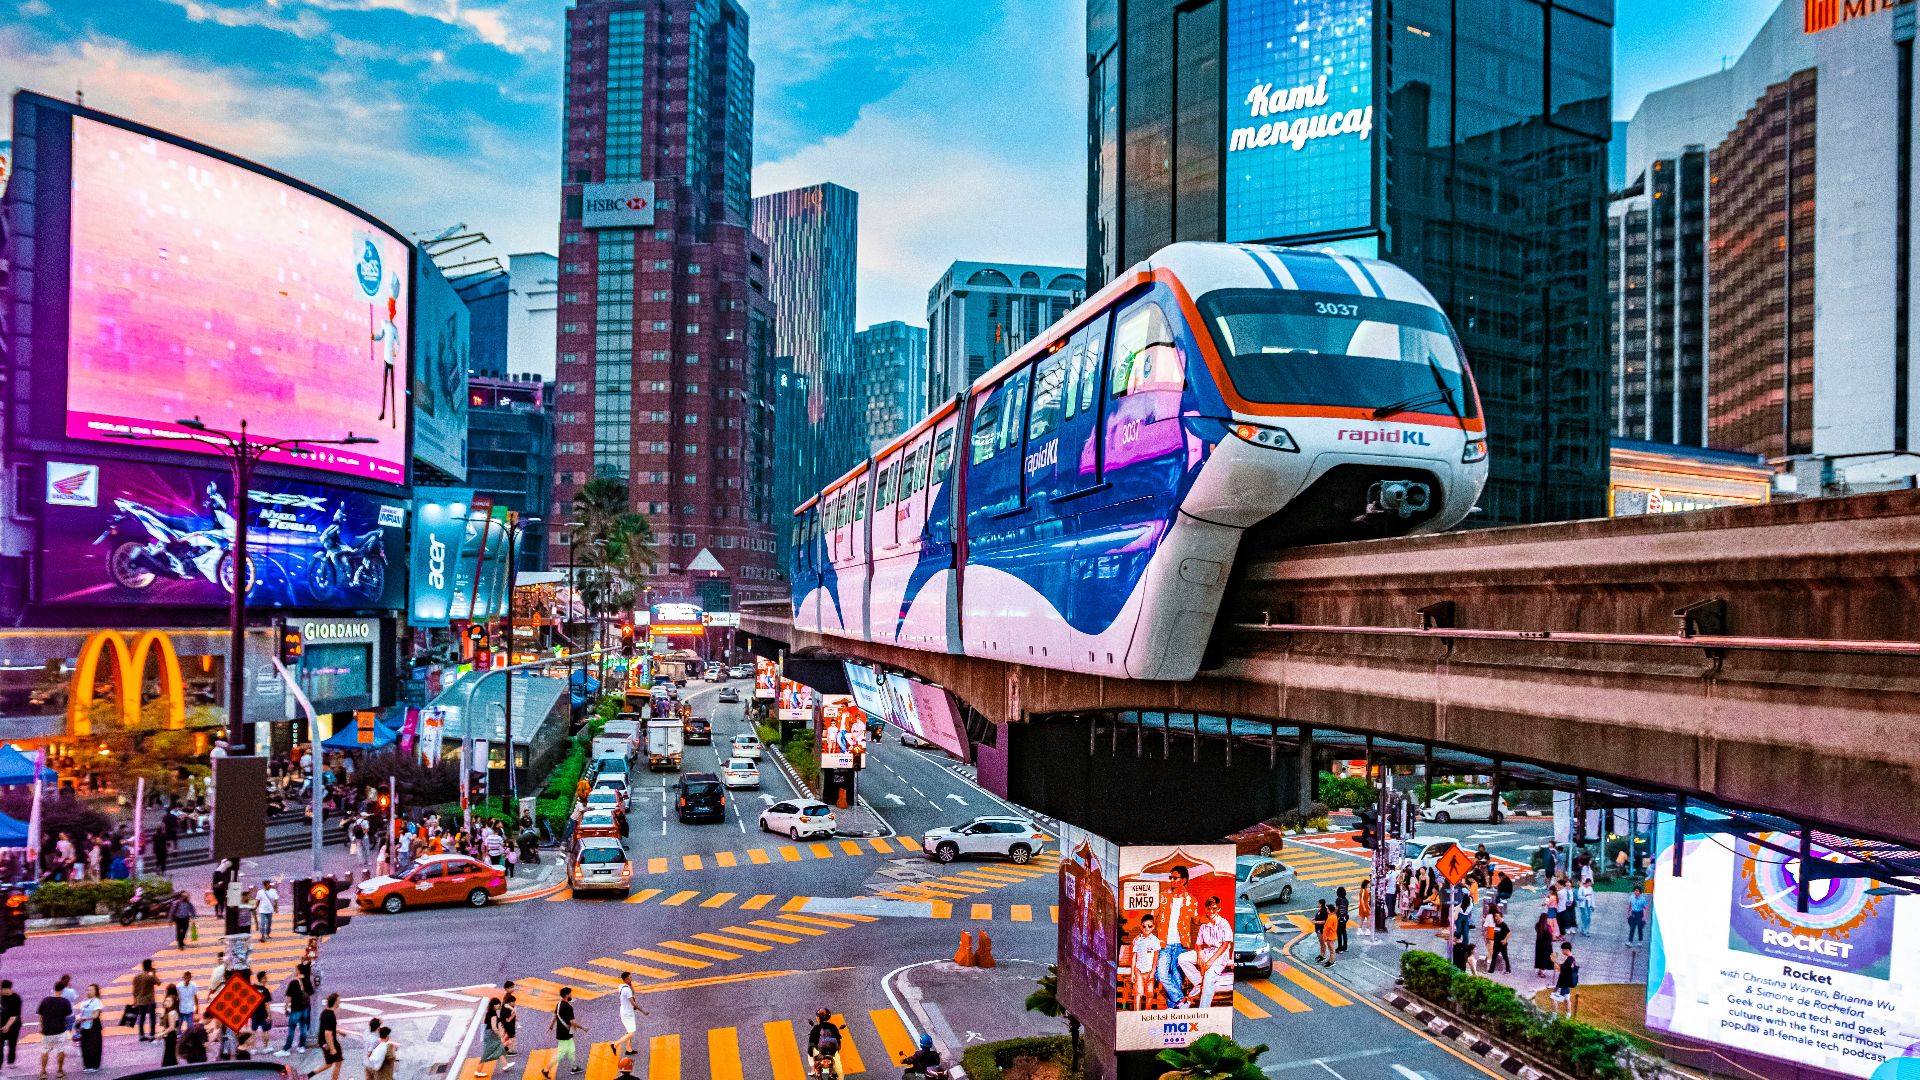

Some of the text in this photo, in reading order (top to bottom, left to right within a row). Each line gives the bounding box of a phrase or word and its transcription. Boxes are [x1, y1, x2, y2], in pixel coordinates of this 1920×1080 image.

[1247, 74, 1329, 117] Kami
[586, 199, 625, 212] HSBC
[1314, 301, 1359, 317] 3037
[1121, 418, 1141, 445] 3037
[1337, 428, 1431, 447] rapidKL
[429, 532, 446, 590] acer
[304, 622, 370, 641] GIORDANO
[1129, 896, 1154, 908] RM59
[1762, 928, 1854, 959] ROCKET
[1782, 965, 1833, 986] Rocket
[1720, 970, 1895, 1012] with Christina Warren, Brianna Wu
[1745, 985, 1865, 1019] & Simone de Rochefort
[1163, 1022, 1199, 1033] max
[1727, 994, 1887, 1037] Geek out about tech and geek
[1728, 1009, 1884, 1050] culture with the first and most
[1720, 1019, 1760, 1033] popular
[1763, 1028, 1814, 1046] all-female
[1816, 1040, 1840, 1052] tech
